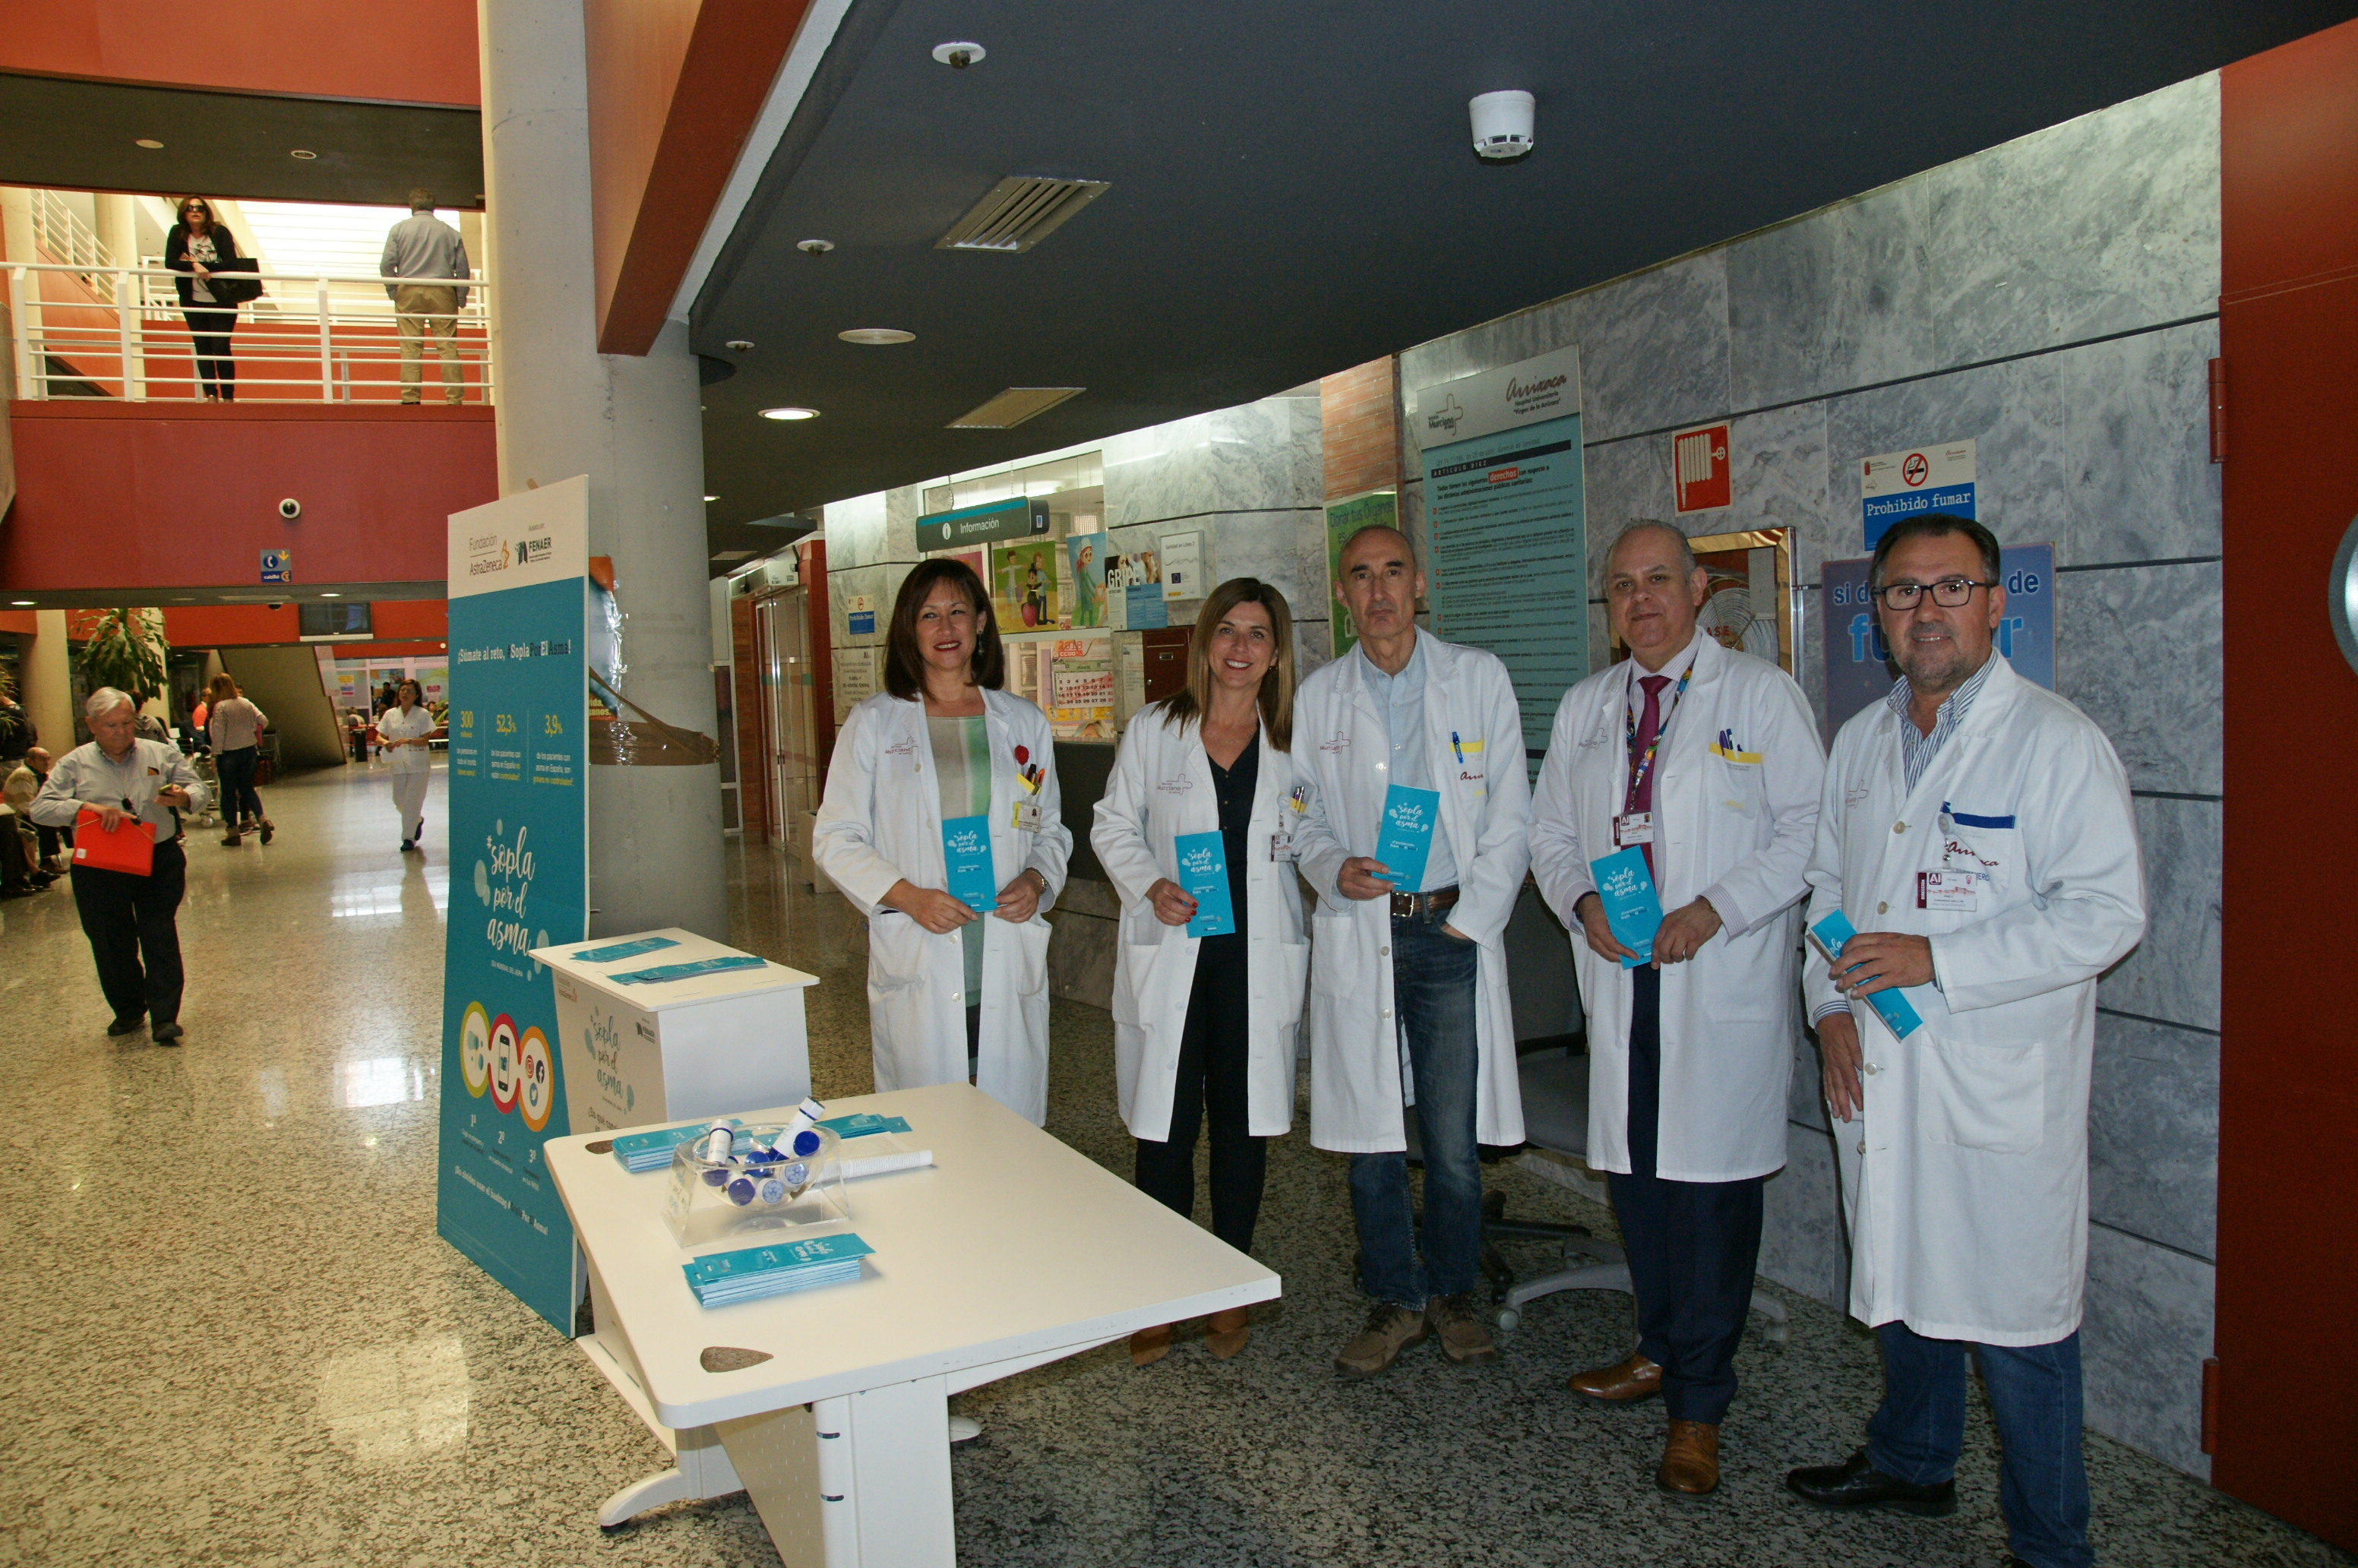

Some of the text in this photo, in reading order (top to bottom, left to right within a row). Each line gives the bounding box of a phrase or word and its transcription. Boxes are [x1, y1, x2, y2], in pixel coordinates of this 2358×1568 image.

[1490, 469, 1517, 482] derechos
[1866, 492, 1971, 517] Prohibido fumar
[960, 518, 1000, 534] Información
[1330, 512, 1350, 528] Donar
[469, 534, 498, 552] Fundación
[529, 536, 552, 553] FENAER
[469, 558, 502, 576] AstraZeneca
[1108, 568, 1141, 587] GRIPE
[2008, 571, 2039, 595] de
[1833, 583, 1851, 605] si
[1059, 640, 1083, 651] 2018
[458, 648, 482, 665] ¡Súmate
[483, 646, 489, 661] al
[490, 648, 505, 662] reto,
[460, 710, 474, 729] 300
[496, 714, 517, 737] 52,3%
[545, 714, 563, 738] 3,9%
[494, 886, 514, 912] por
[487, 918, 531, 956] asma
